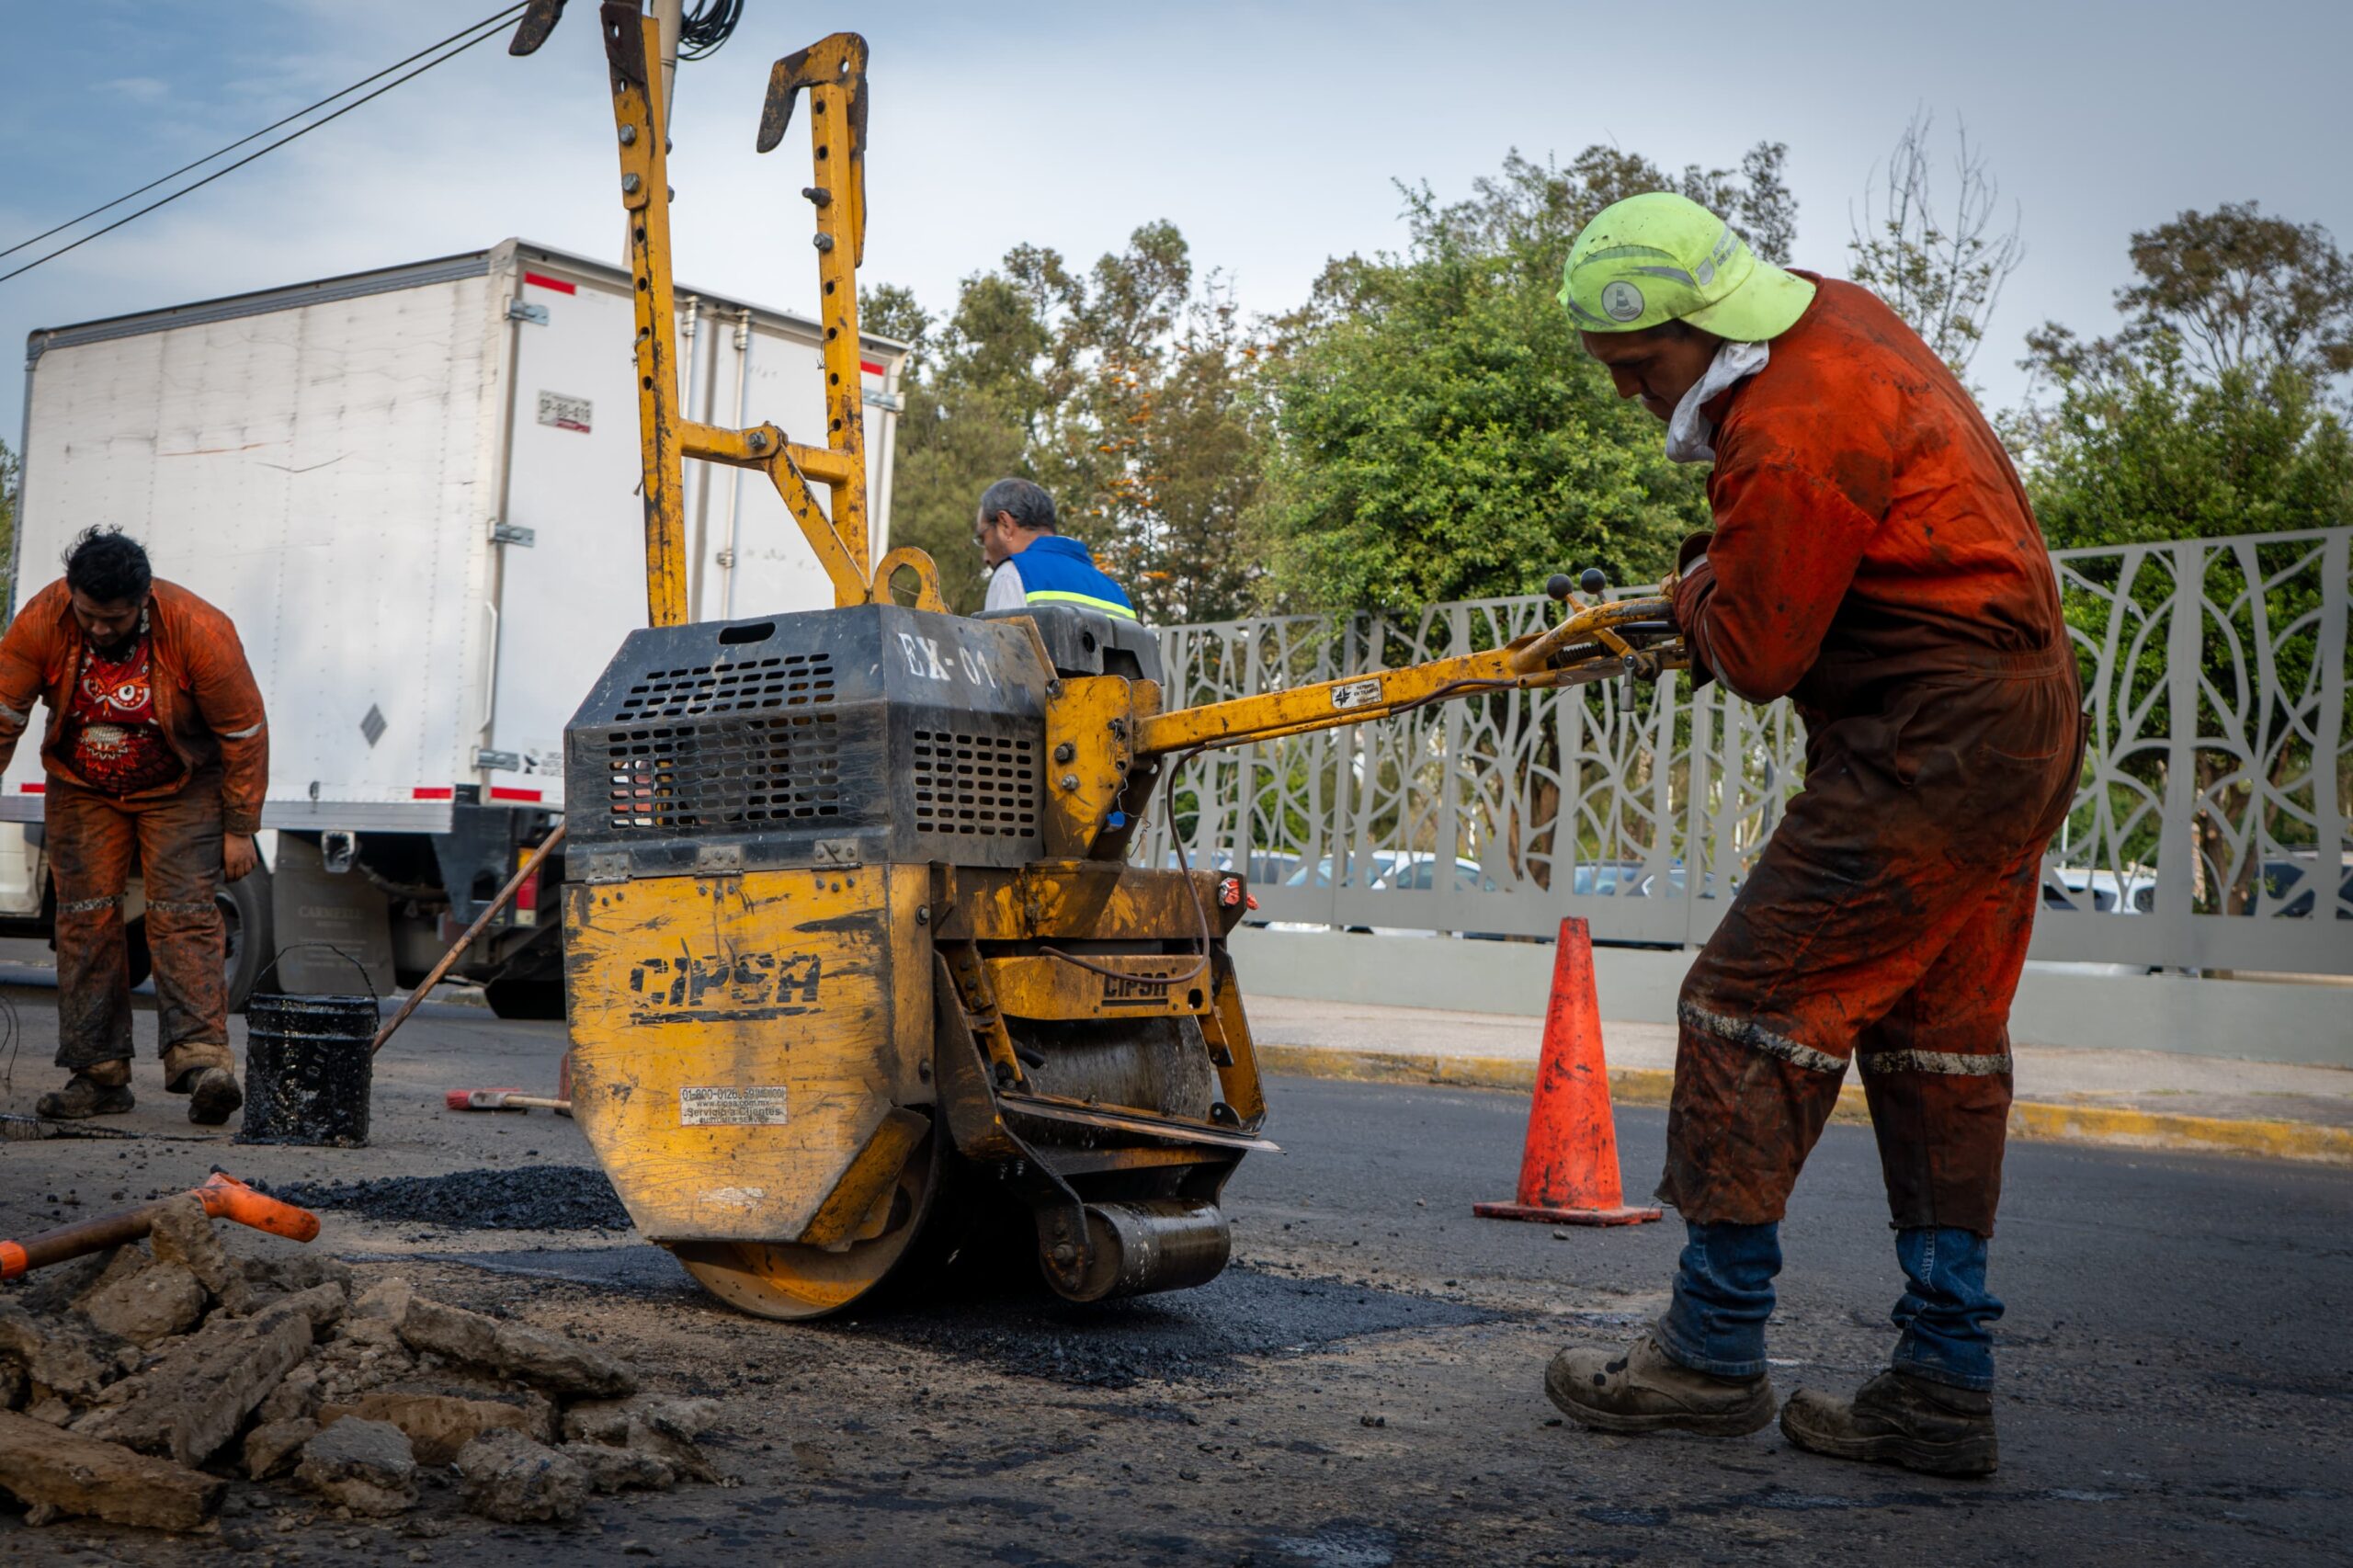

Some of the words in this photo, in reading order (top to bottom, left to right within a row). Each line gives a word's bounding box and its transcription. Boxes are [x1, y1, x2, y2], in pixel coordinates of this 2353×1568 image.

[897, 632, 996, 689] EX-01
[629, 952, 822, 1008] CIPSA
[1104, 972, 1168, 997] CIPSA
